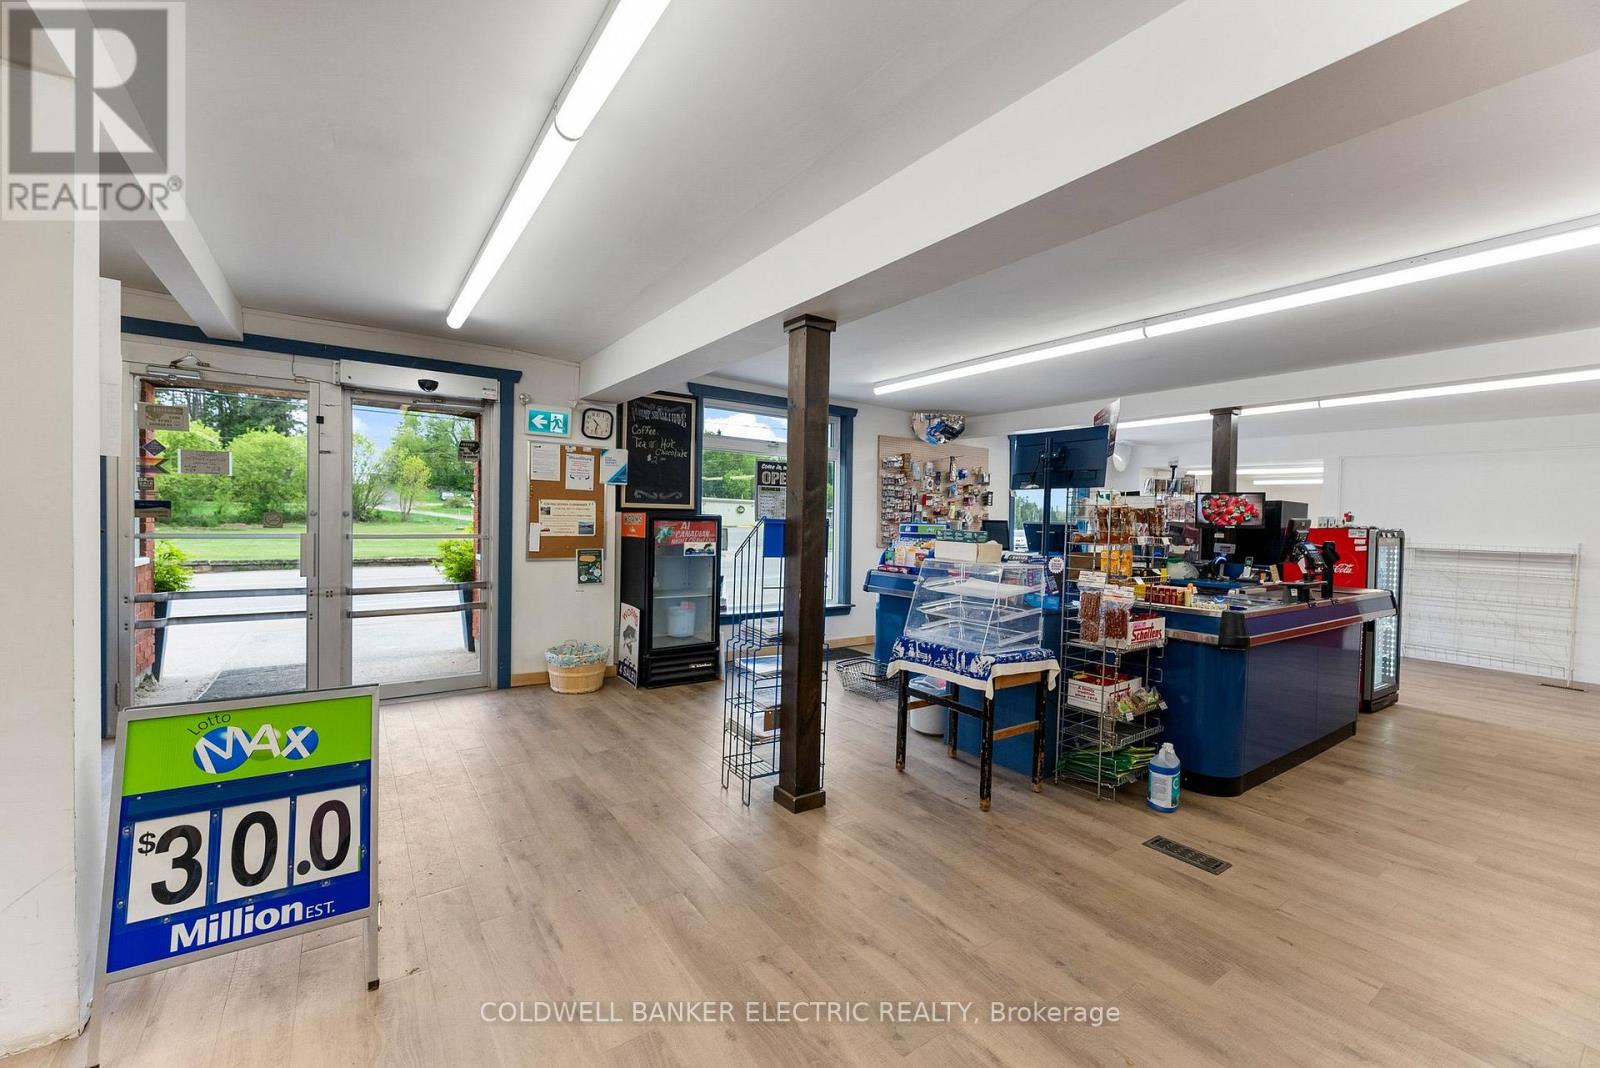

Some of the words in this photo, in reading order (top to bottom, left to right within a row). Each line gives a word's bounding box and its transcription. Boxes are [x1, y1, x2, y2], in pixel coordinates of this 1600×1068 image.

[633, 436, 646, 448] Tea
[661, 437, 676, 449] Hot
[655, 448, 688, 457] Chocolate
[761, 471, 787, 485] OPE
[675, 530, 711, 538] CANADIAN
[187, 711, 232, 736] Lotto
[169, 901, 303, 952] Million
[305, 900, 336, 920] EST.
